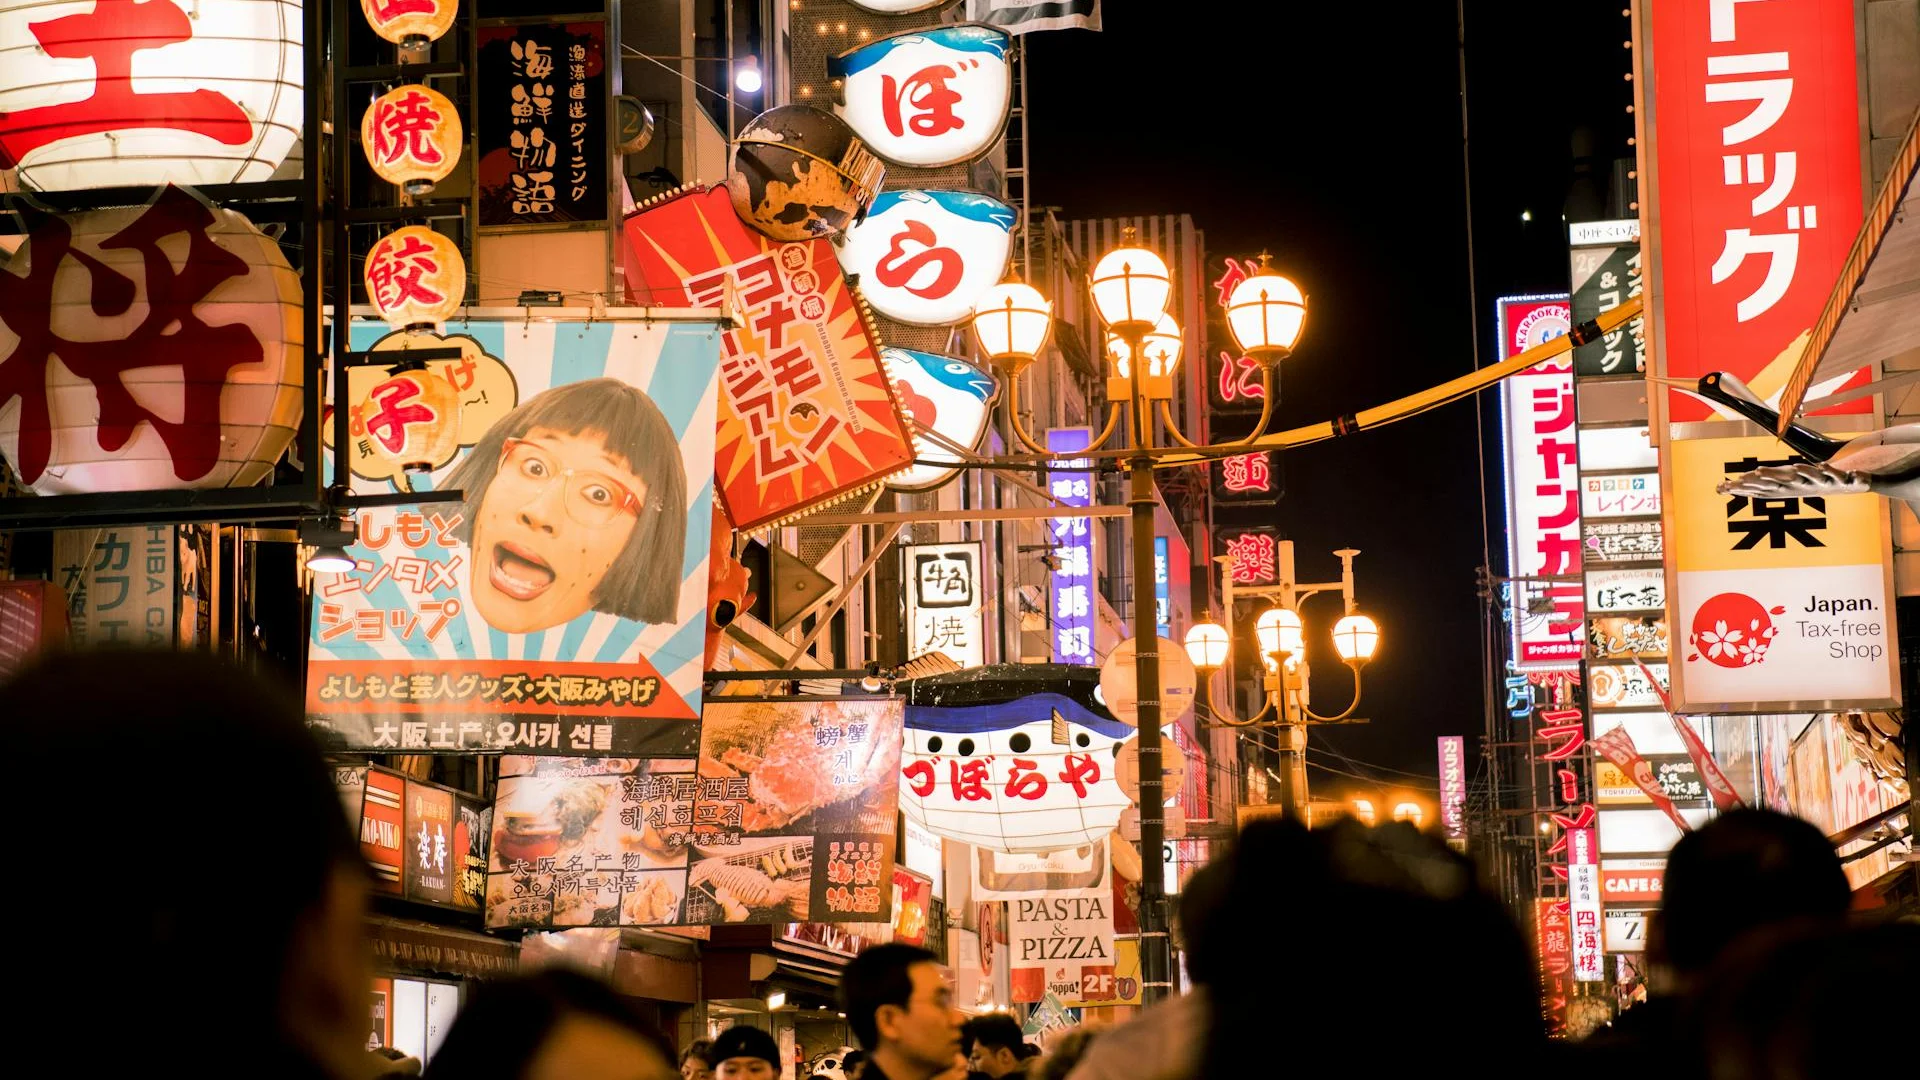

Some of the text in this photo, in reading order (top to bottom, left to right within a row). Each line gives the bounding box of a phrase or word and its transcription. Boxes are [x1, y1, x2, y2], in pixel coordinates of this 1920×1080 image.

[372, 91, 443, 165] 焼
[510, 40, 557, 214] 海鮮物語
[366, 237, 444, 311] 餃
[366, 377, 436, 454] 子
[352, 512, 464, 551] しもと
[924, 563, 967, 595] 牛角
[1597, 584, 1665, 608] ぼて茶
[1804, 595, 1879, 614] Japan.
[320, 598, 461, 643] ショップ
[1796, 620, 1881, 639] Tax-free
[1829, 641, 1882, 661] Shop
[569, 723, 613, 750] 선물
[621, 776, 750, 805] 海鮮居酒屋
[902, 753, 1101, 802] づぼらや
[669, 832, 742, 847] 海鮮居酒屋
[509, 851, 641, 878] 大阪名产物
[511, 875, 640, 901] 오오사까특산품
[1605, 878, 1663, 893] CAFE &
[1017, 897, 1108, 922] PASTA
[1052, 923, 1068, 937] &
[1021, 935, 1108, 961] PIZZA
[1084, 974, 1114, 993] 2F
